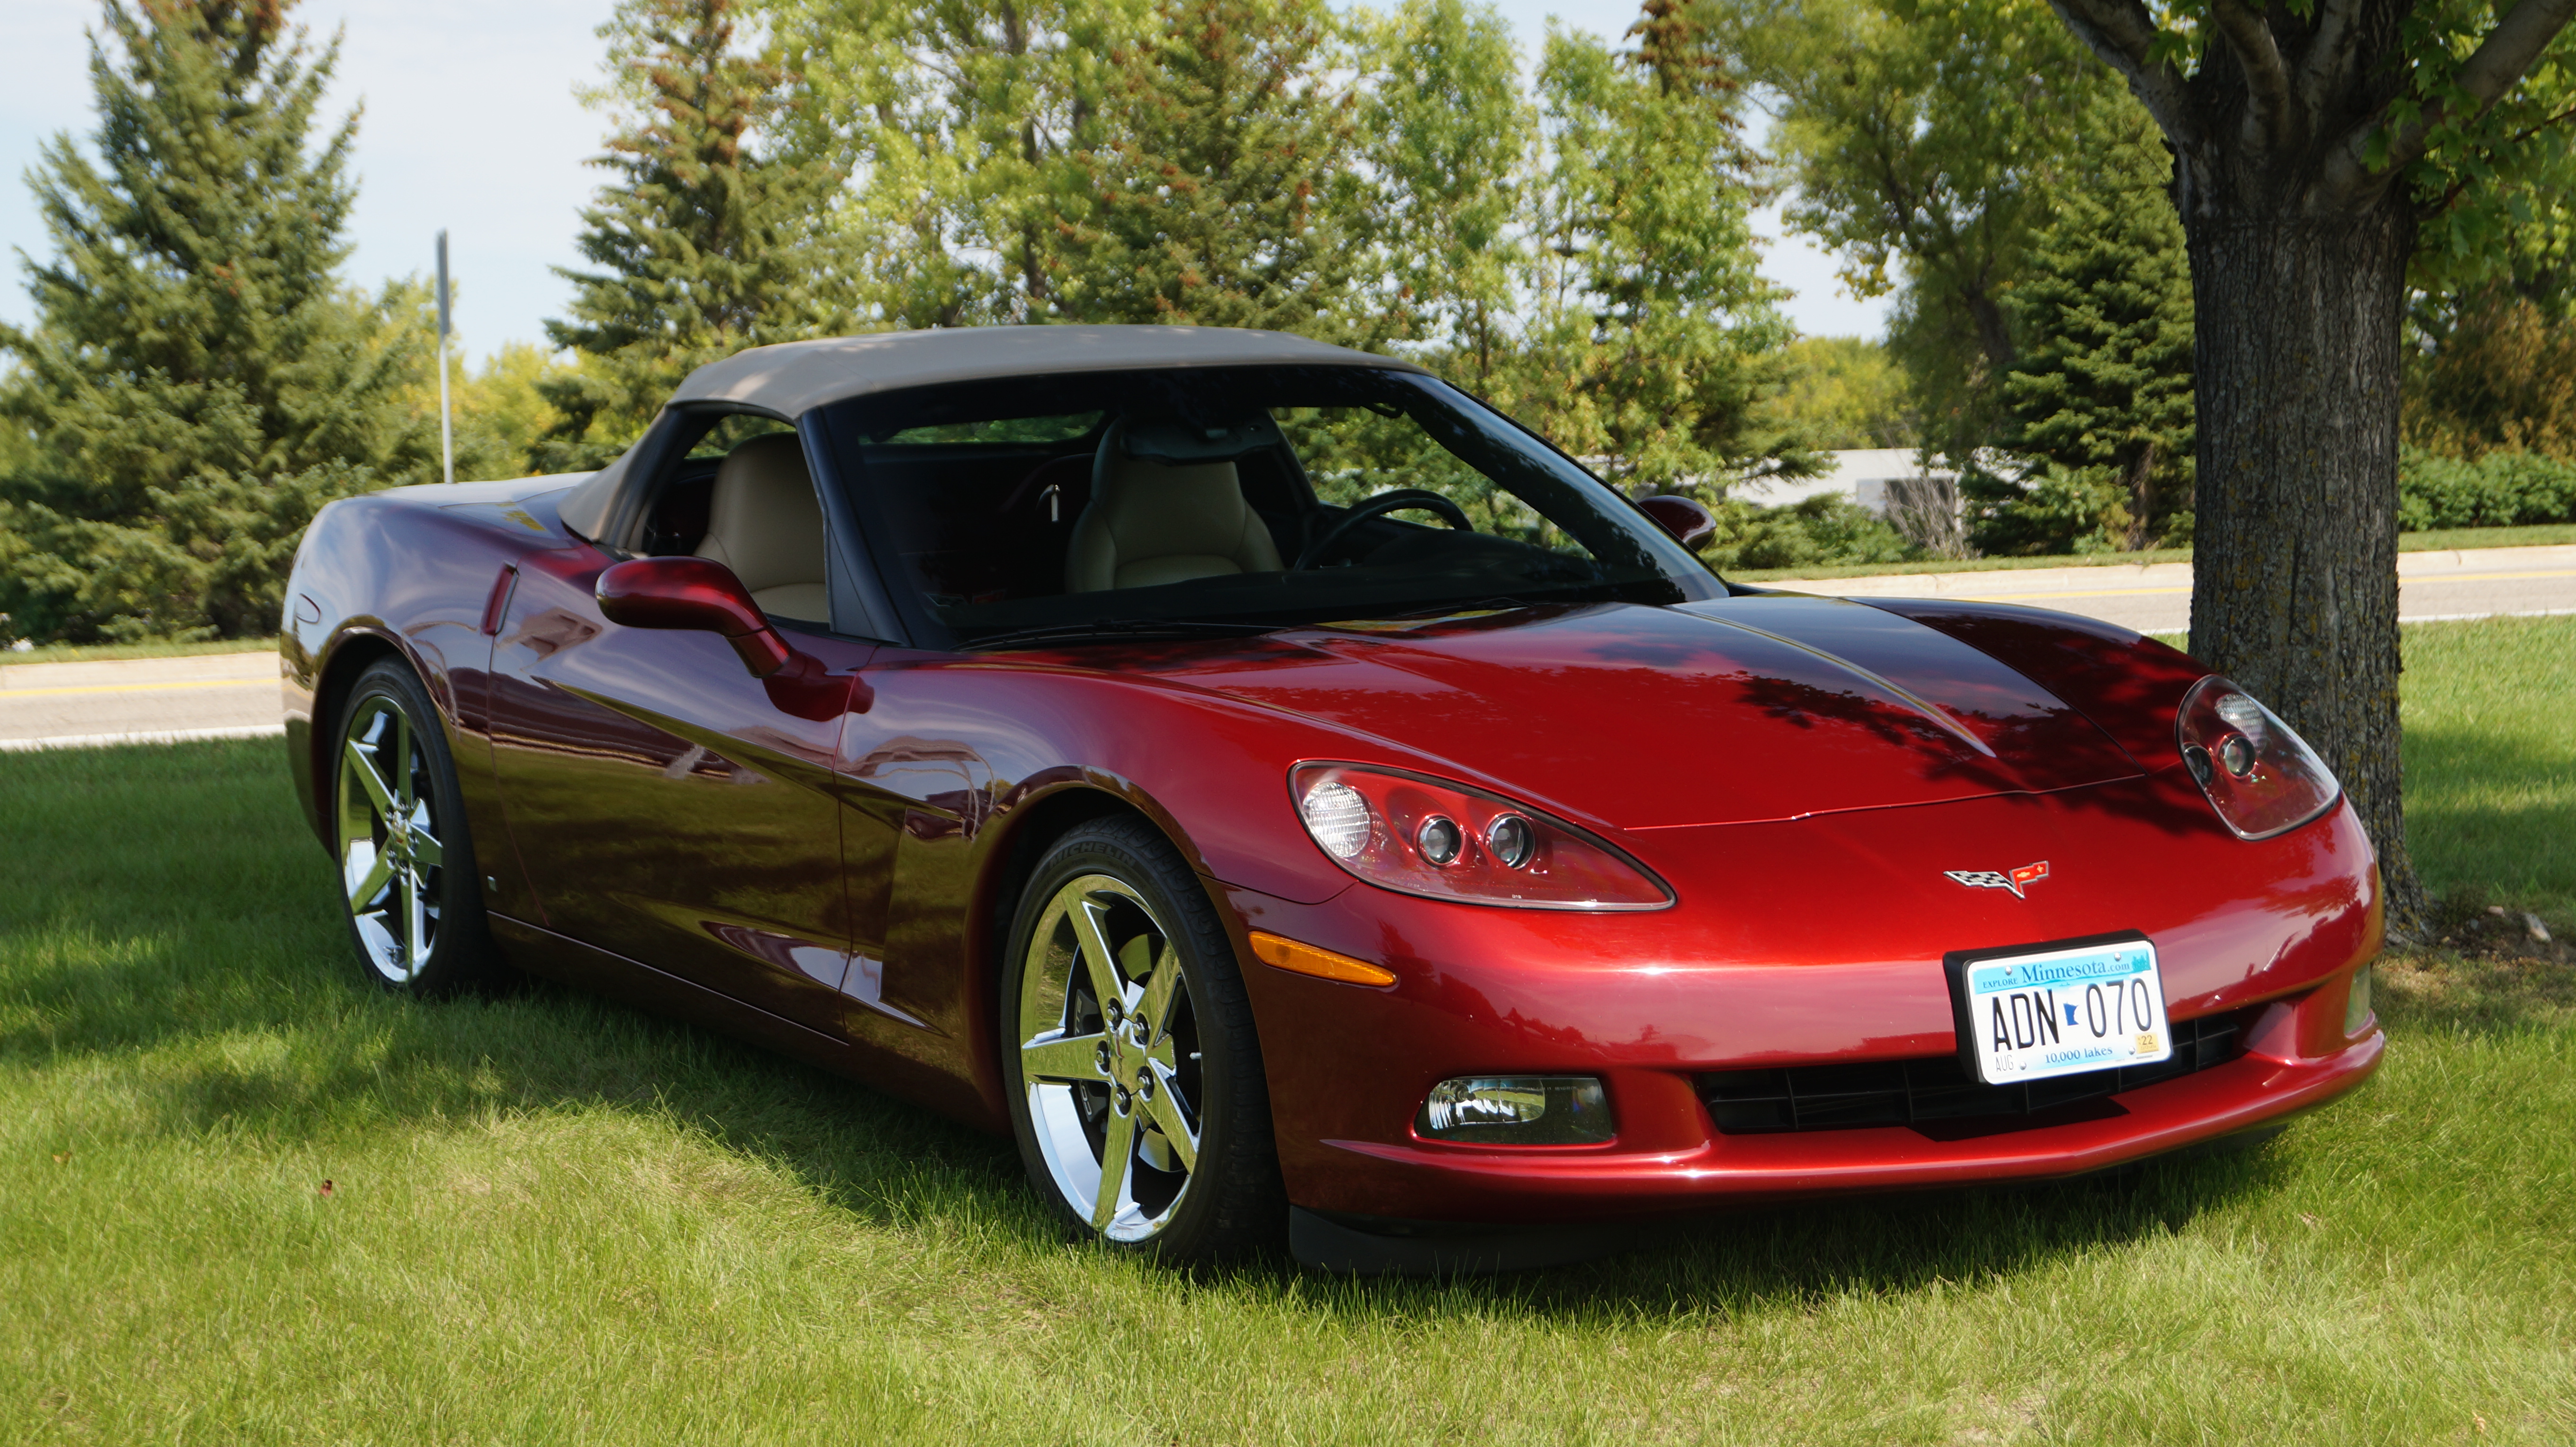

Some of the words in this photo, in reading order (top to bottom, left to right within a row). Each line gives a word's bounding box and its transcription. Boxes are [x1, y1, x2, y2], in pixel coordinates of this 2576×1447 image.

[1049, 841, 1136, 869] MICHELIN
[1983, 977, 2018, 989] EXPLORE
[1992, 988, 2060, 1052] ADN
[2086, 978, 2152, 1038] 070
[2141, 1034, 2153, 1046] 22
[1995, 1054, 2014, 1072] AUG
[2044, 1049, 2081, 1064] 10,000
[2084, 1047, 2113, 1058] lakes
